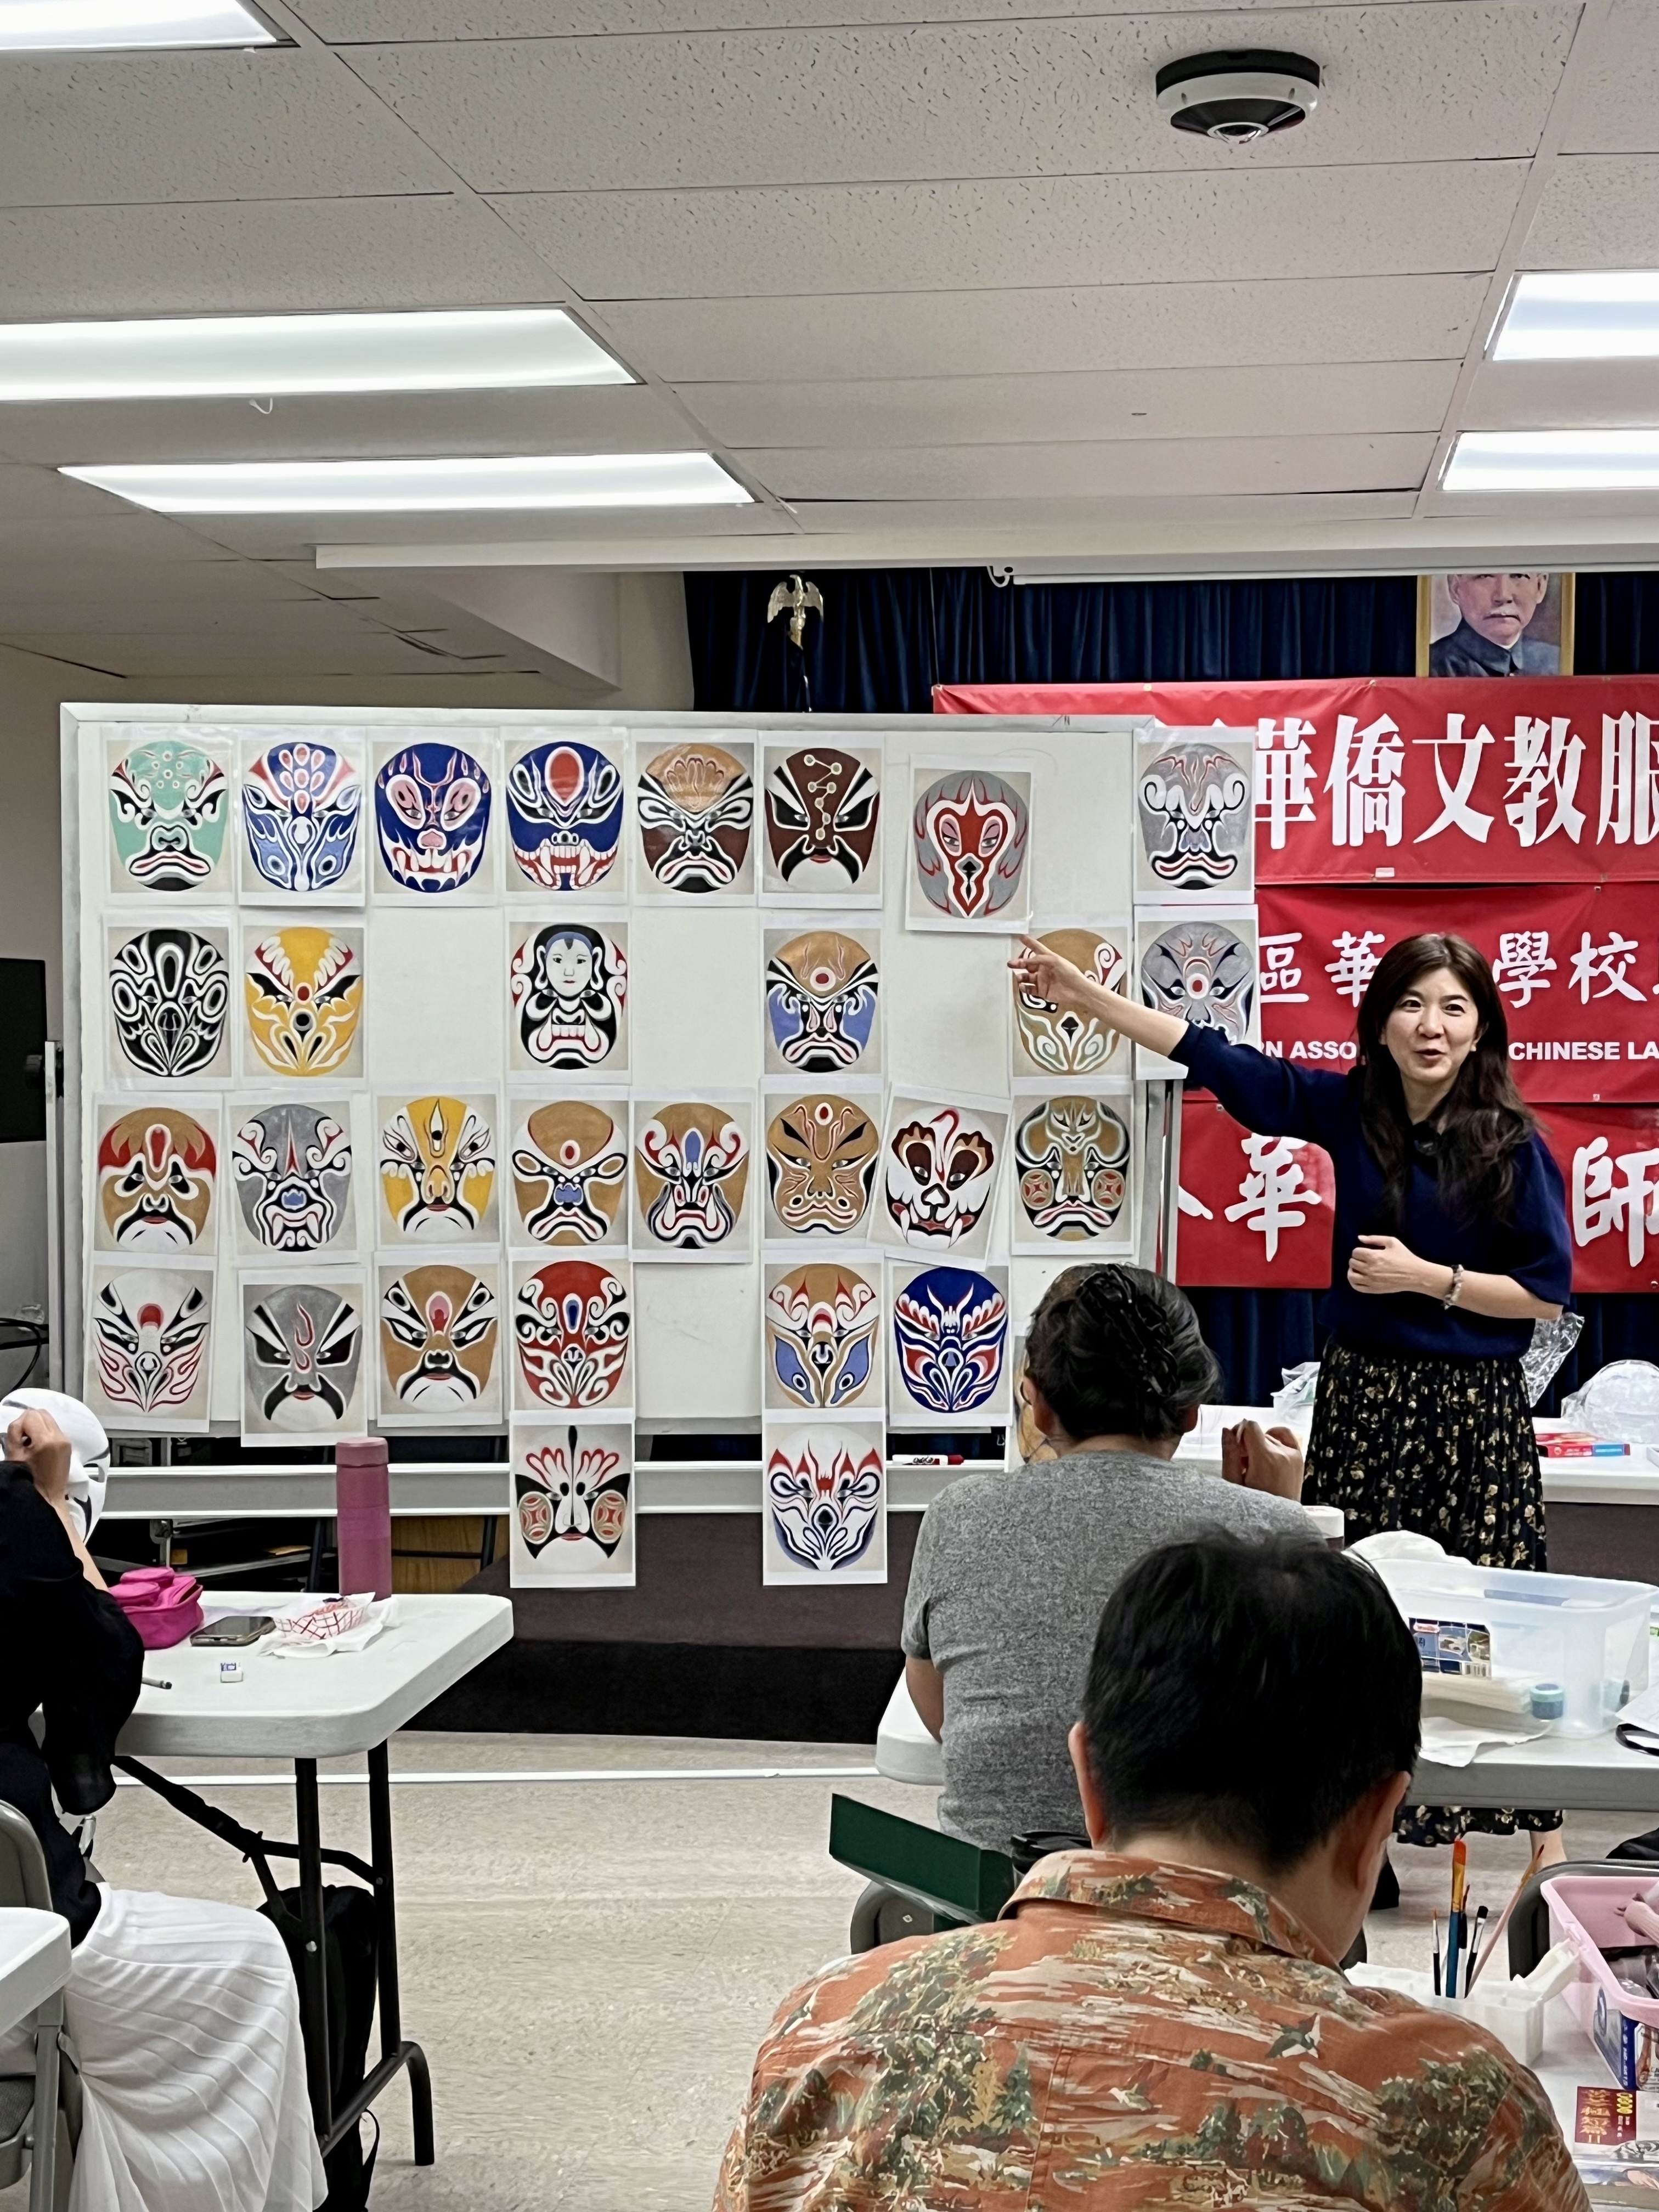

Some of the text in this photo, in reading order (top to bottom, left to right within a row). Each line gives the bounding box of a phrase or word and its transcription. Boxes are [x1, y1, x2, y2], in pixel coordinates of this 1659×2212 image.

[1492, 931, 1659, 1008] 學校
[1289, 1041, 1357, 1059] ASSO
[1509, 1041, 1620, 1060] CHINESE
[1628, 1041, 1659, 1059] LA
